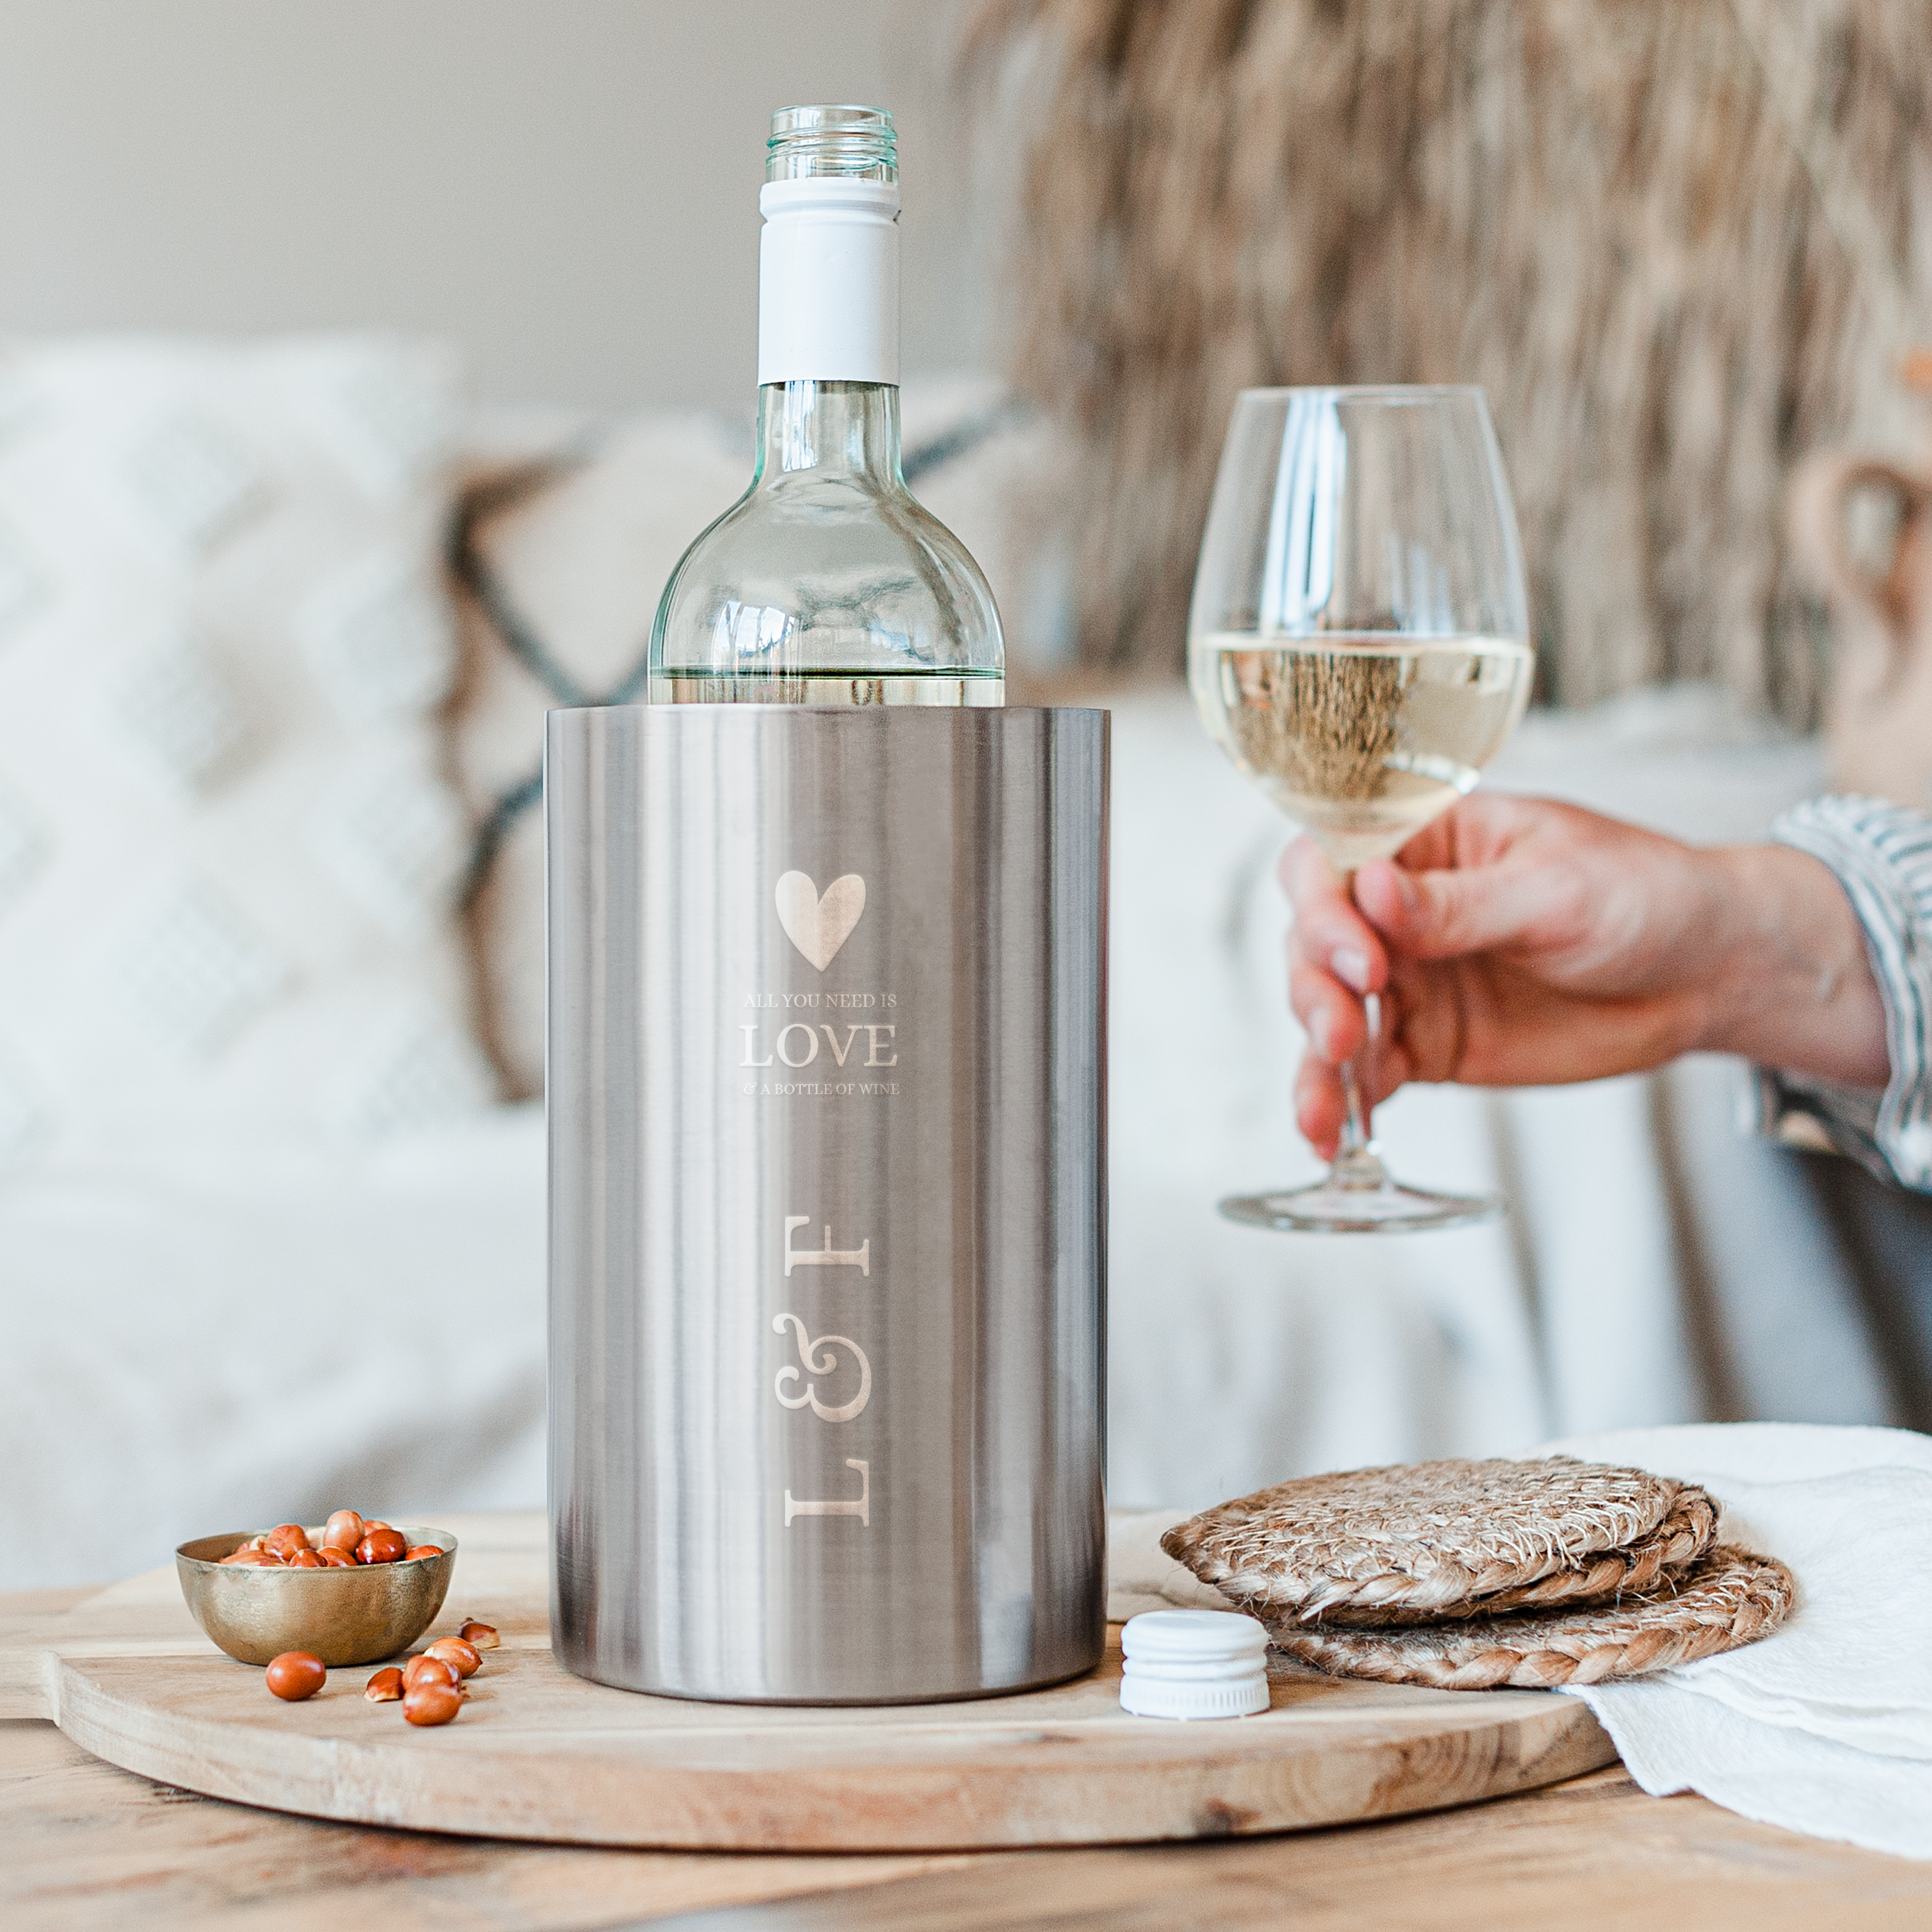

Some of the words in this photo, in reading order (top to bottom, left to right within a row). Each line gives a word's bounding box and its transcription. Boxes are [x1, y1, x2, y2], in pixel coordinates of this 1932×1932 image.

[743, 994, 778, 1008] ALL
[782, 994, 820, 1008] YOU
[826, 994, 875, 1008] NEED
[880, 994, 897, 1008] IS
[739, 1024, 897, 1067] LOVE
[743, 1082, 757, 1095] &
[760, 1084, 771, 1095] A
[774, 1084, 832, 1095] BOTTLE
[836, 1084, 855, 1095] OF
[859, 1084, 900, 1095] WINE
[784, 1215, 870, 1277] F
[772, 1313, 872, 1423] &
[784, 1458, 870, 1527] L
